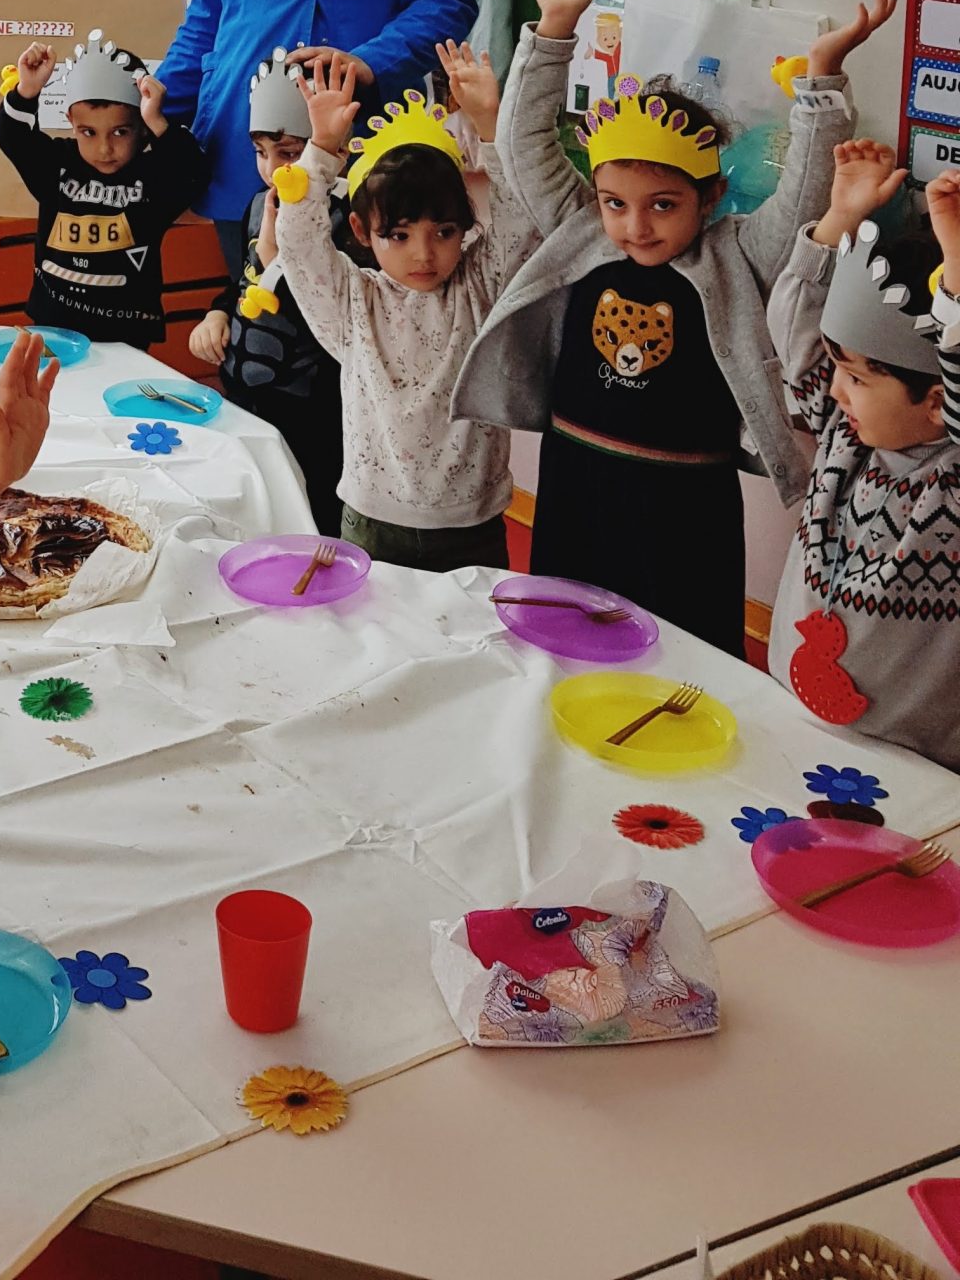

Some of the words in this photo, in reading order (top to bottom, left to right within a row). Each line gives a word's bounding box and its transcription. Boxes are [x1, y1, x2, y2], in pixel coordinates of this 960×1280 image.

[920, 73, 960, 94] AUJ
[59, 222, 119, 244] 1996
[72, 256, 89, 268] %80
[58, 294, 113, 317] RUNNING
[116, 310, 141, 320] OUT
[653, 995, 680, 1010] 550
